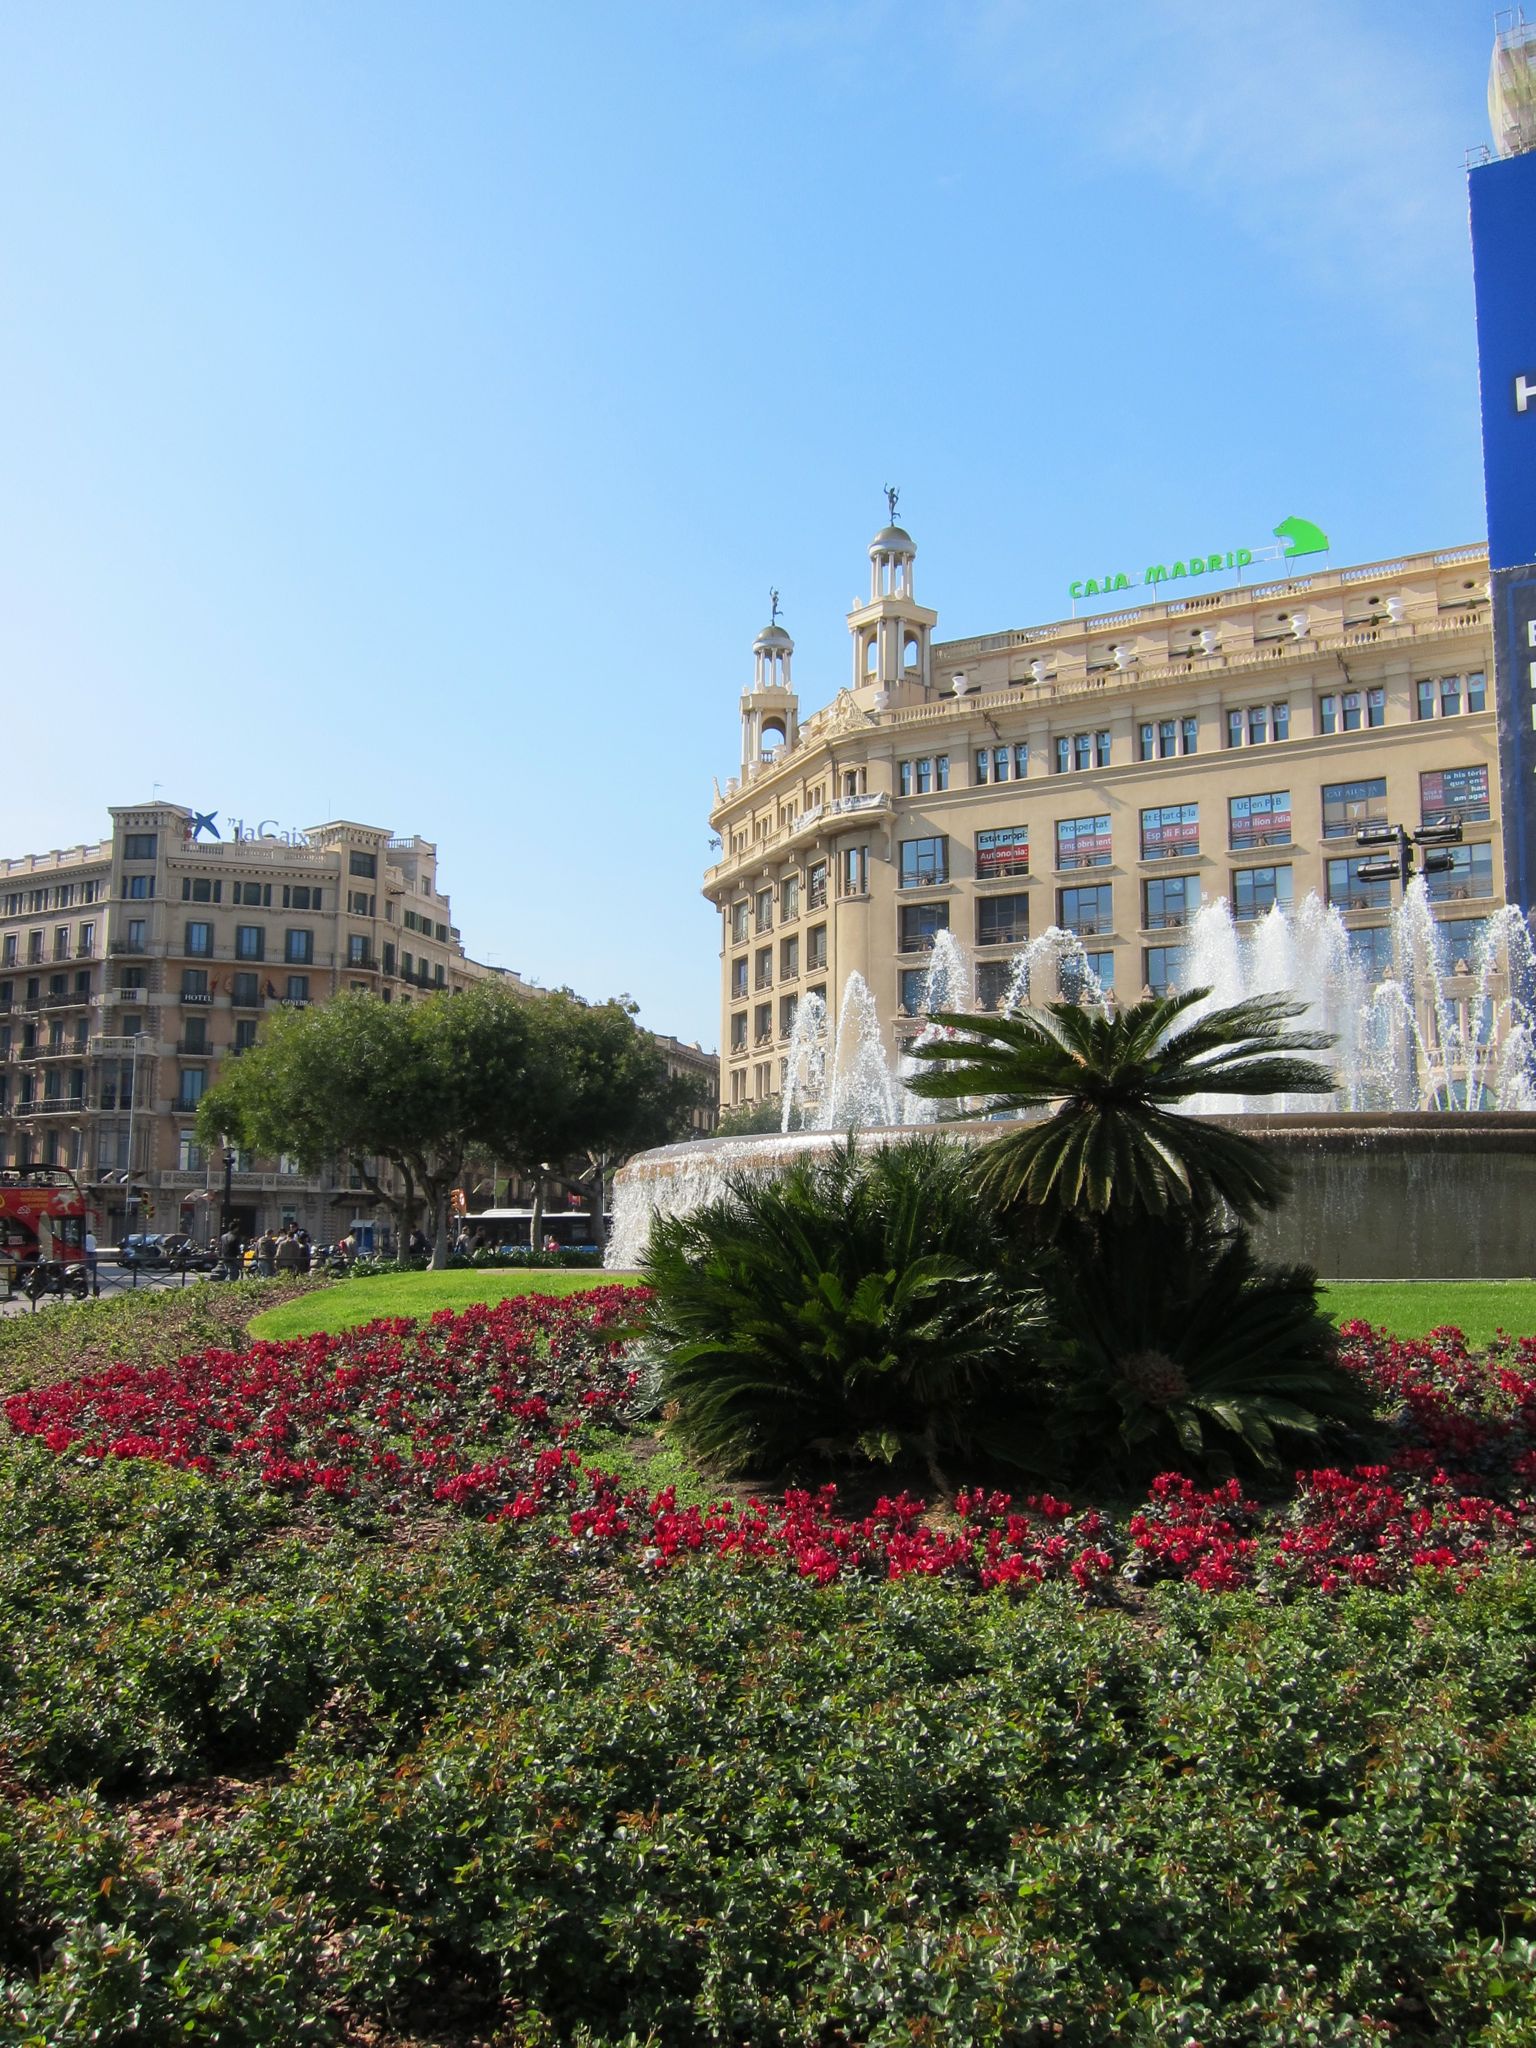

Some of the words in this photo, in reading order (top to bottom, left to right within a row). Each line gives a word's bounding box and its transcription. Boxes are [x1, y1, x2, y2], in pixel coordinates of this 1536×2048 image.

[1069, 573, 1128, 598] CAJA
[1144, 549, 1252, 585] MADRID
[1060, 820, 1109, 833] Propertat
[1174, 826, 1197, 837] Fscal
[184, 994, 212, 1002] HOTEL
